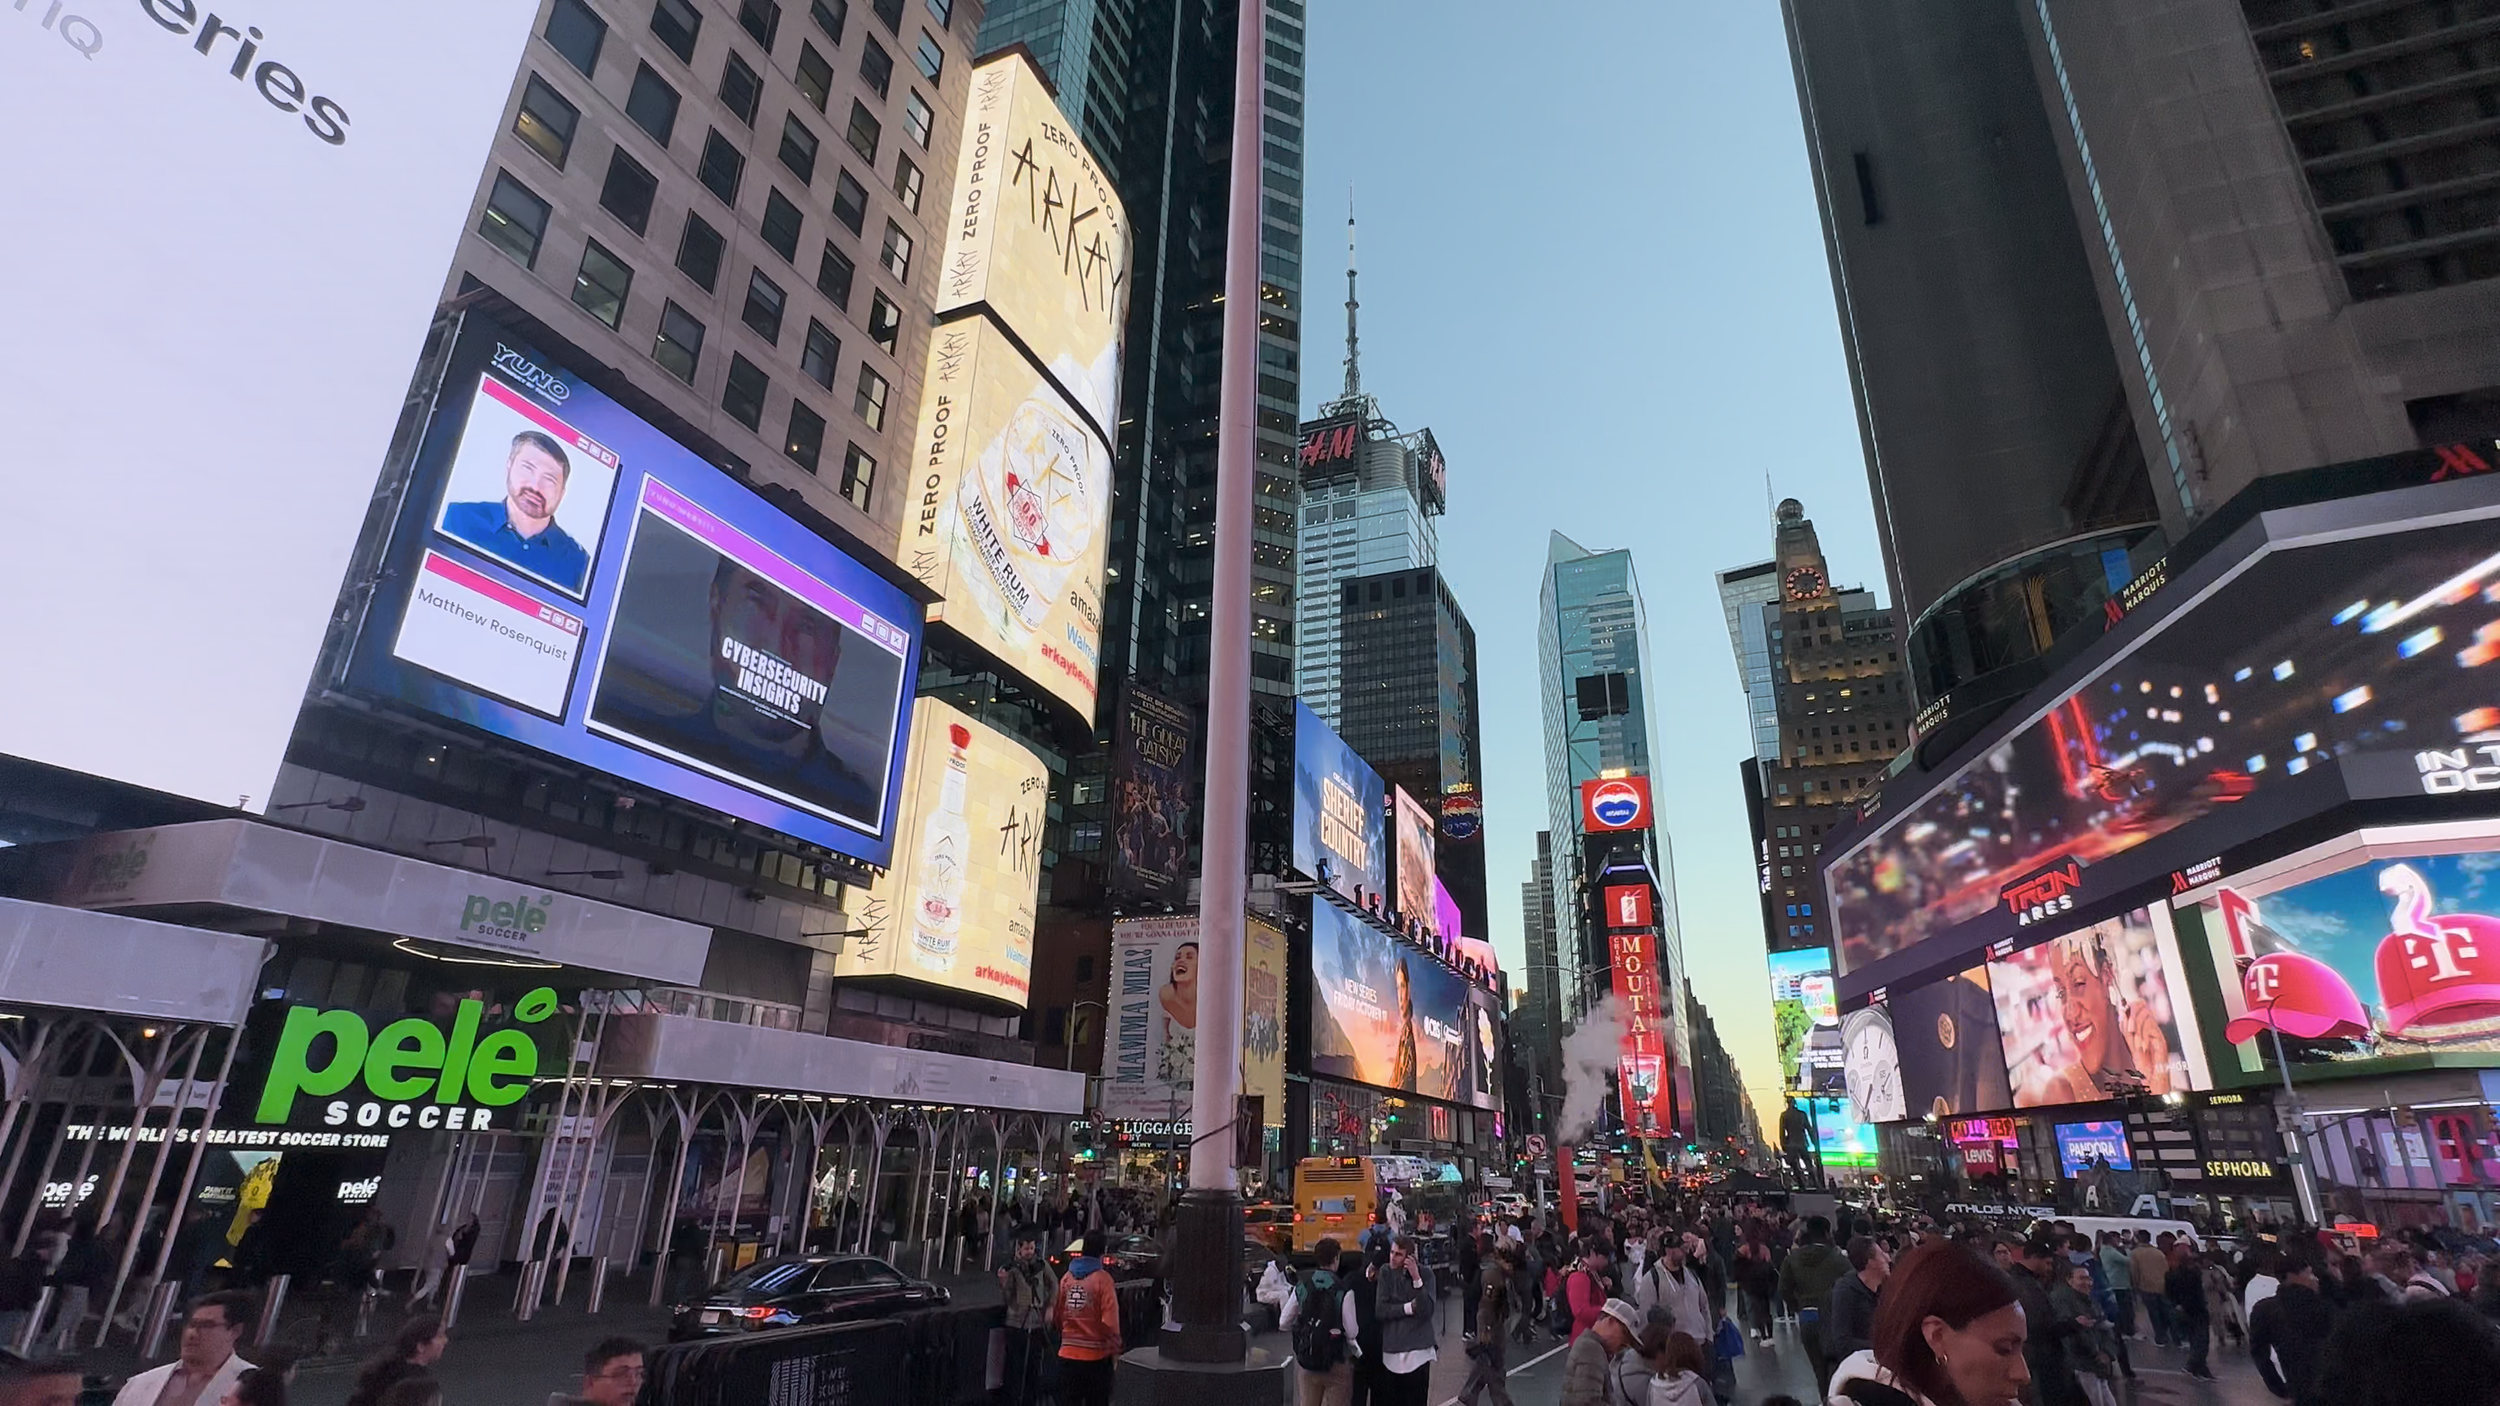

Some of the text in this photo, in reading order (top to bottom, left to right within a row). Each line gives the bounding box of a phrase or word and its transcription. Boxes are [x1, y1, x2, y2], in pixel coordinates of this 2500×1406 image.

[971, 123, 991, 185] PROOF
[1041, 122, 1077, 159] ZERO
[962, 189, 981, 241] ZERO
[1012, 137, 1123, 324] ARKAY
[494, 341, 570, 400] YUNO
[929, 395, 952, 466] PROOF
[1052, 429, 1070, 454] ZERO
[1300, 424, 1357, 468] H&M
[919, 474, 941, 536] ZERO
[973, 495, 1030, 605] WHITE RUM
[2122, 556, 2168, 599] MARRIOTT
[2126, 574, 2166, 611] MARQUIS
[417, 588, 568, 662] Matthew Rosenquist
[721, 636, 828, 705] CYBERSECURITY
[737, 667, 801, 714] INSIGHTS
[1916, 694, 1951, 724] MARRIOTT
[1130, 713, 1151, 737] THE
[1152, 725, 1188, 754] GREAT
[1918, 709, 1948, 735] MARQUIS
[1136, 736, 1182, 767] GATSBY
[2415, 748, 2468, 773] IN
[1020, 776, 1040, 795] ZERO
[1323, 776, 1365, 836] SHERIFF
[1321, 810, 1367, 872] COUNTRY
[2186, 856, 2222, 877] MARRIOTT
[2188, 868, 2221, 886] MARQUIS
[2002, 863, 2081, 914] TRON
[460, 895, 553, 933] pelé
[2018, 894, 2074, 926] ARES
[477, 925, 527, 942] SOCCER
[1123, 949, 1152, 995] MIA!
[1344, 977, 1377, 1004] NEW SERIES
[1621, 936, 1648, 1053] MOUTAI
[255, 987, 557, 1124] pelé
[1116, 1001, 1149, 1084] MAMMA
[324, 1101, 493, 1131] SOCCER
[2209, 1094, 2243, 1105] SEPHORA
[279, 1132, 340, 1147] SOCCER
[342, 1133, 389, 1148] STORE
[1123, 1121, 1193, 1135] LUGGAGE
[2068, 1140, 2116, 1158] PANDORA
[41, 1174, 99, 1201] peé
[337, 1175, 381, 1199] pelé
[2206, 1161, 2272, 1177] SEPHORA
[1944, 1203, 2005, 1215] ATHLOS
